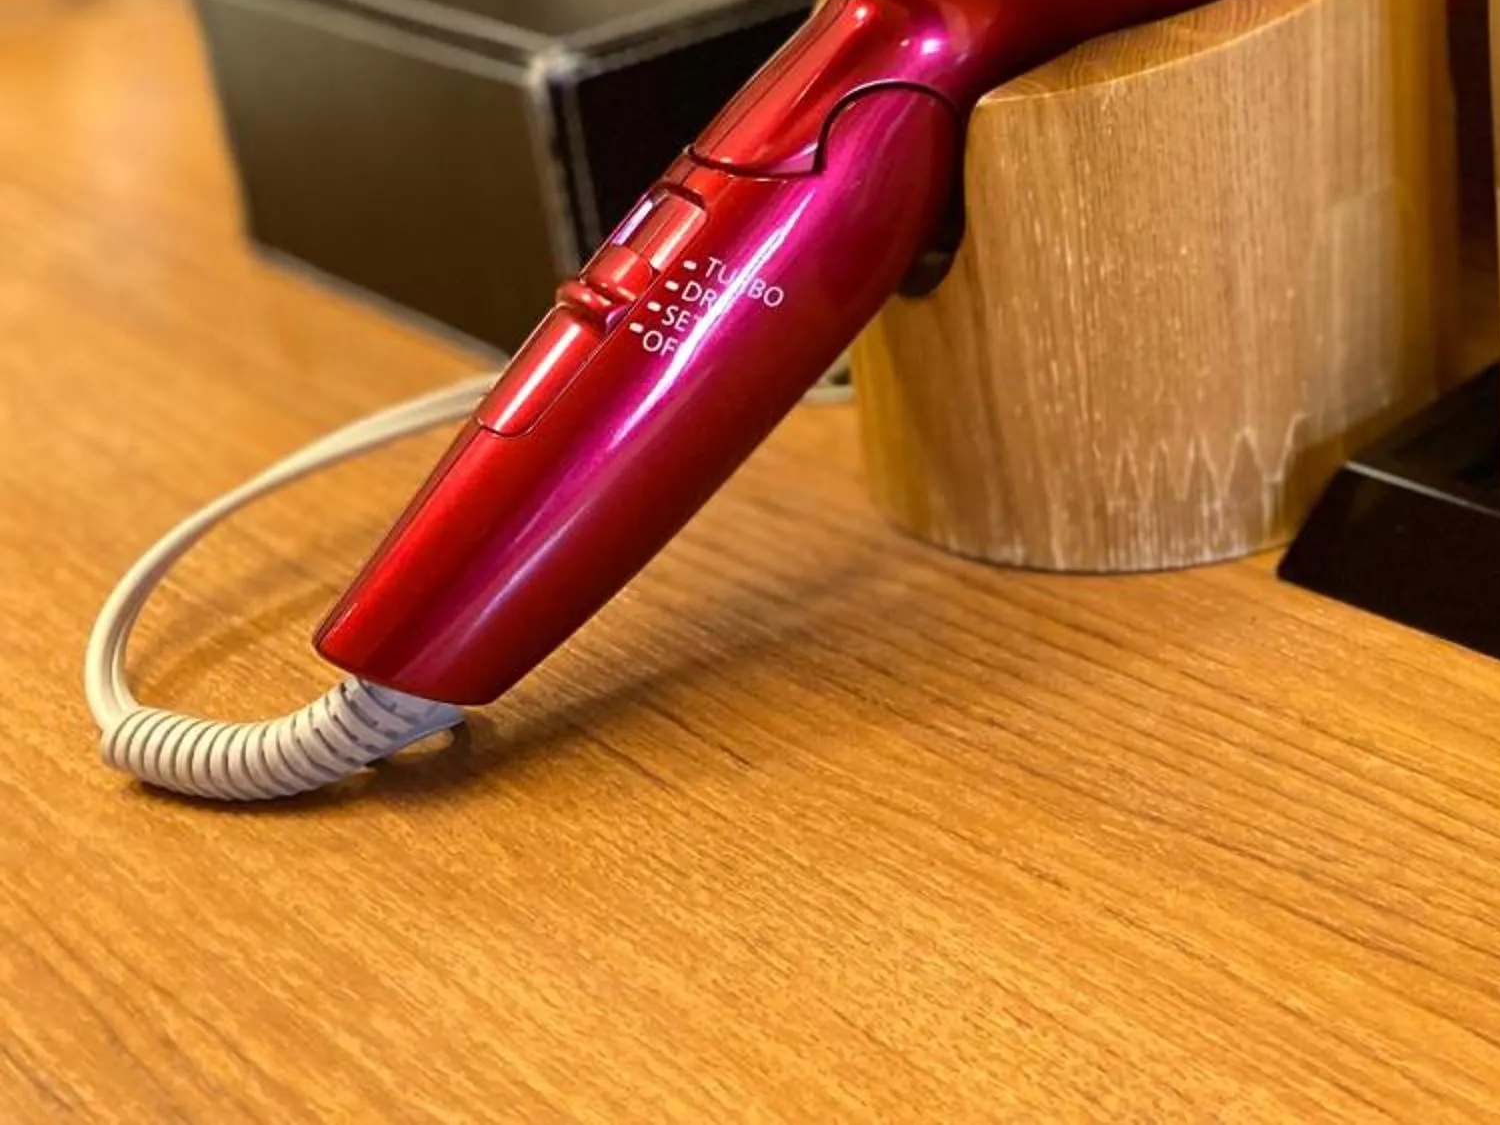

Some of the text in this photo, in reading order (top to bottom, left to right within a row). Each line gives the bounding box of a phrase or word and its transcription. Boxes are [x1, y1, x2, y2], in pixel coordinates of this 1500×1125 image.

[681, 280, 727, 313] DR
[705, 257, 785, 308] TUBO
[643, 330, 683, 357] OF
